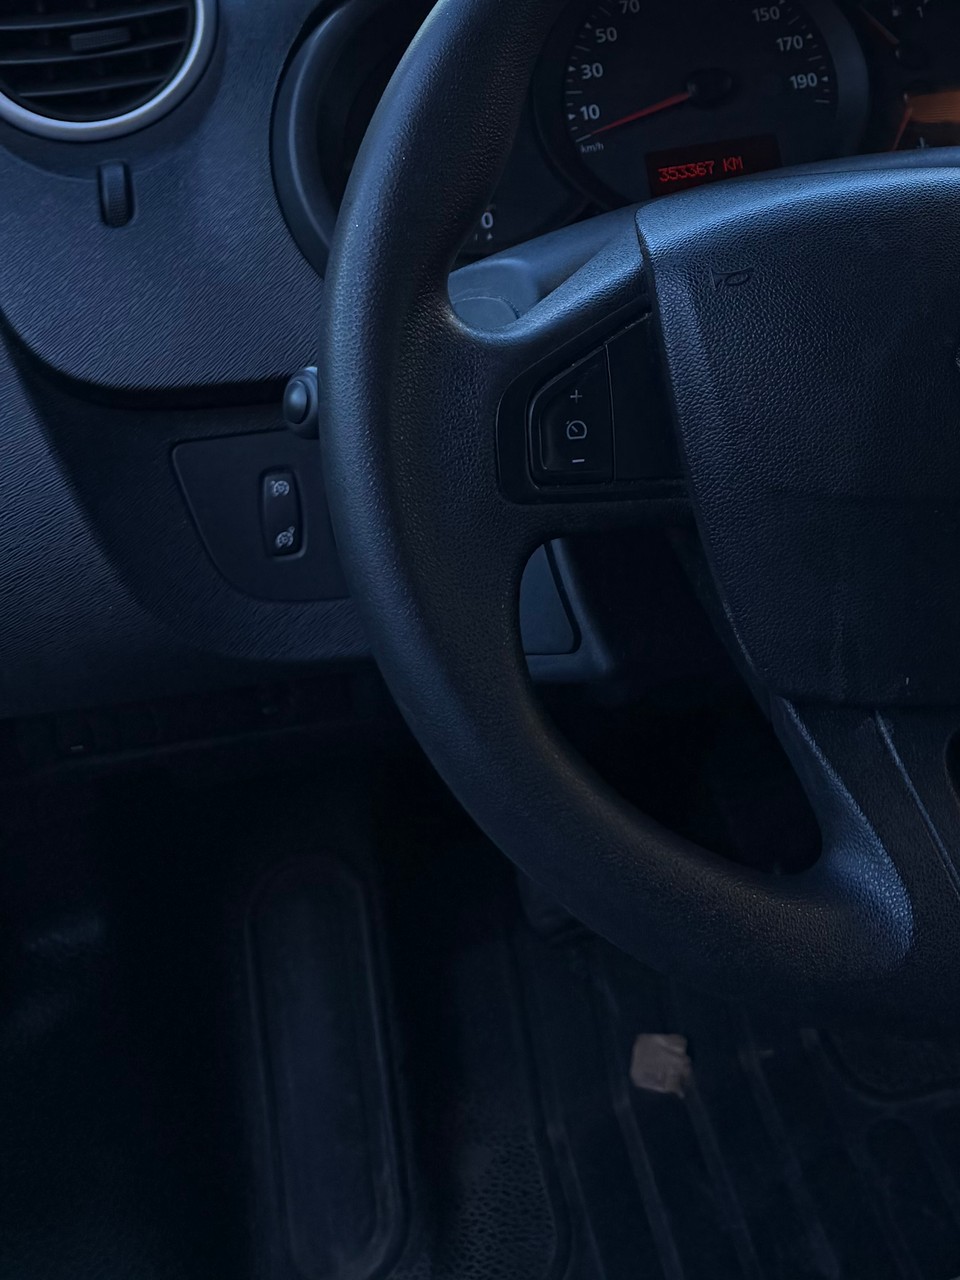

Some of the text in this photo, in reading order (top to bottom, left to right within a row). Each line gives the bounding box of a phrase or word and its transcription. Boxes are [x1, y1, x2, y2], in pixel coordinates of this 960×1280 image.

[751, 5, 780, 22] 150
[595, 26, 618, 44] 50
[776, 34, 804, 52] 170
[580, 61, 604, 80] 30
[789, 72, 818, 90] 190
[579, 103, 601, 121] 10
[658, 155, 744, 182] 353367 KM
